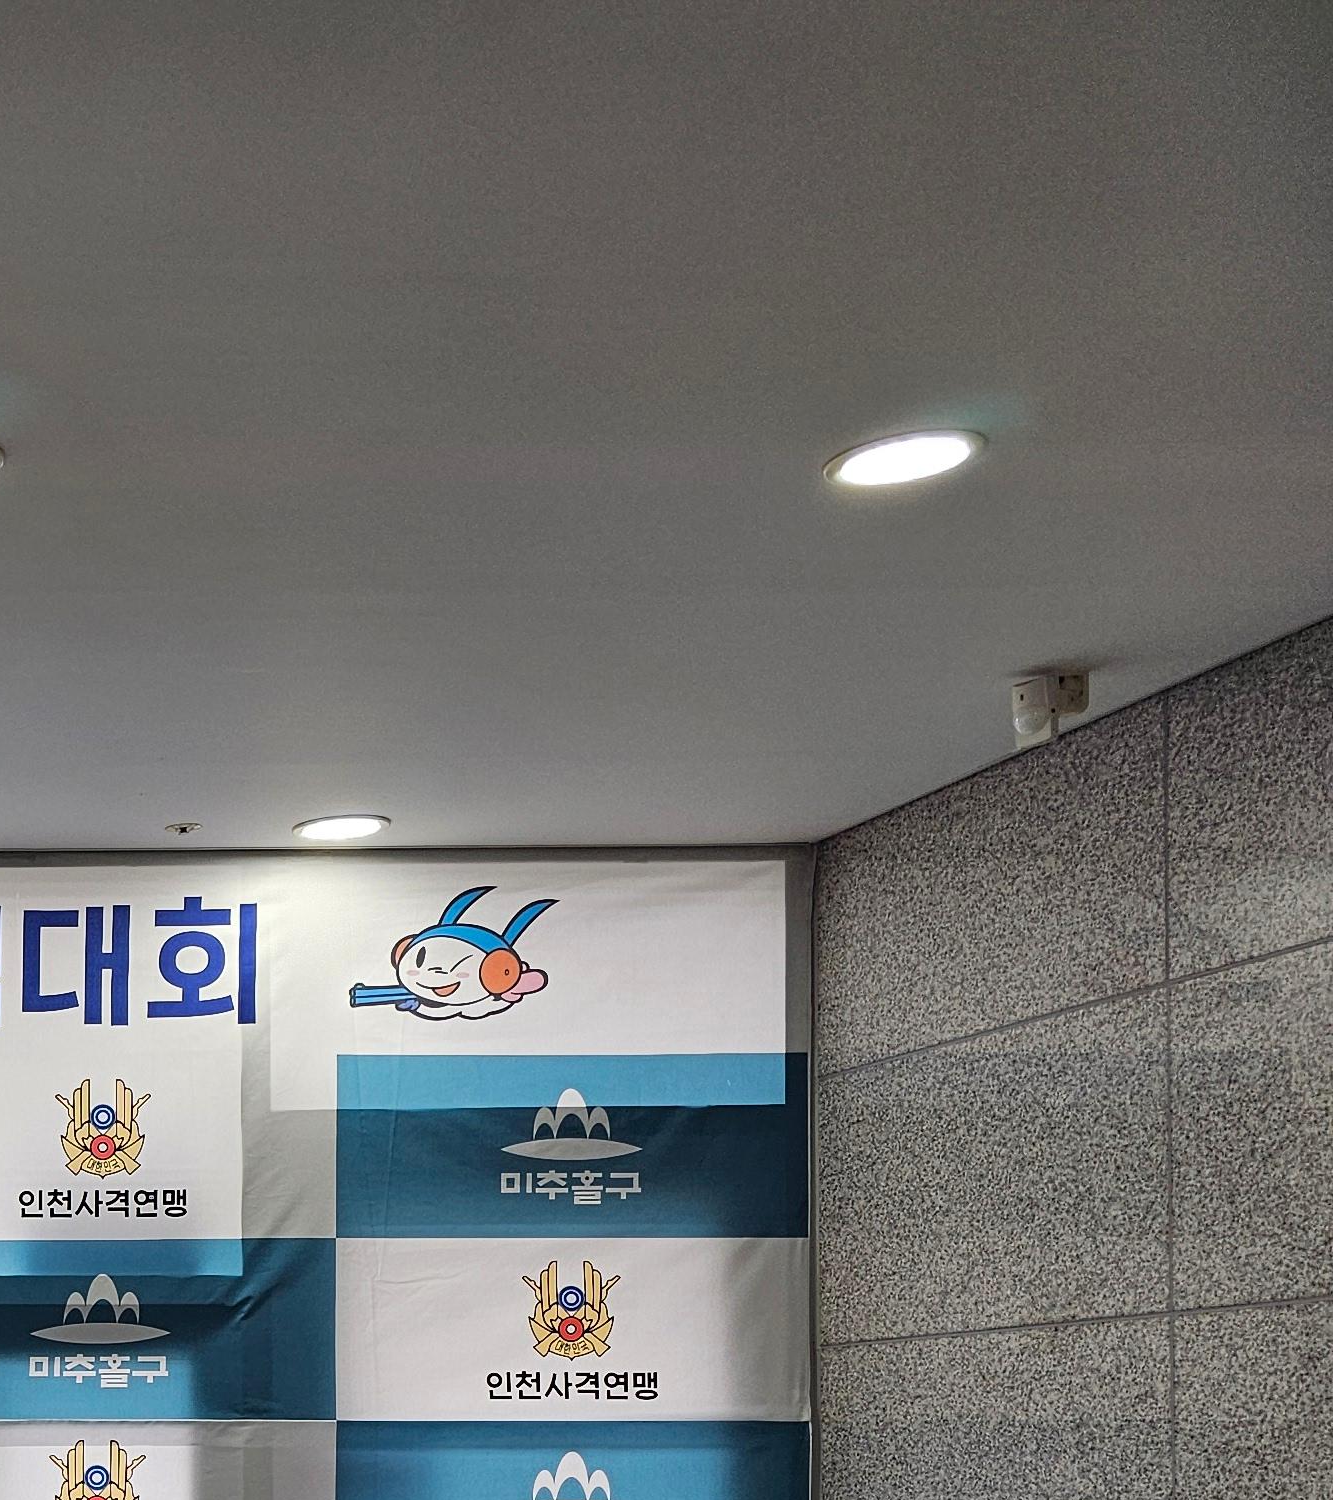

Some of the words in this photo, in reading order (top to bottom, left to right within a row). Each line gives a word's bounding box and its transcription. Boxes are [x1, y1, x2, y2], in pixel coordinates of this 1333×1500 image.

[86, 1157, 120, 1172] 대한민국
[501, 1170, 641, 1204] 미추홀구
[19, 1189, 187, 1217] 인천사격연맹
[554, 1340, 589, 1354] 대한민국
[29, 1354, 168, 1387] 미추홀구
[487, 1371, 658, 1400] 인천사격연맹
